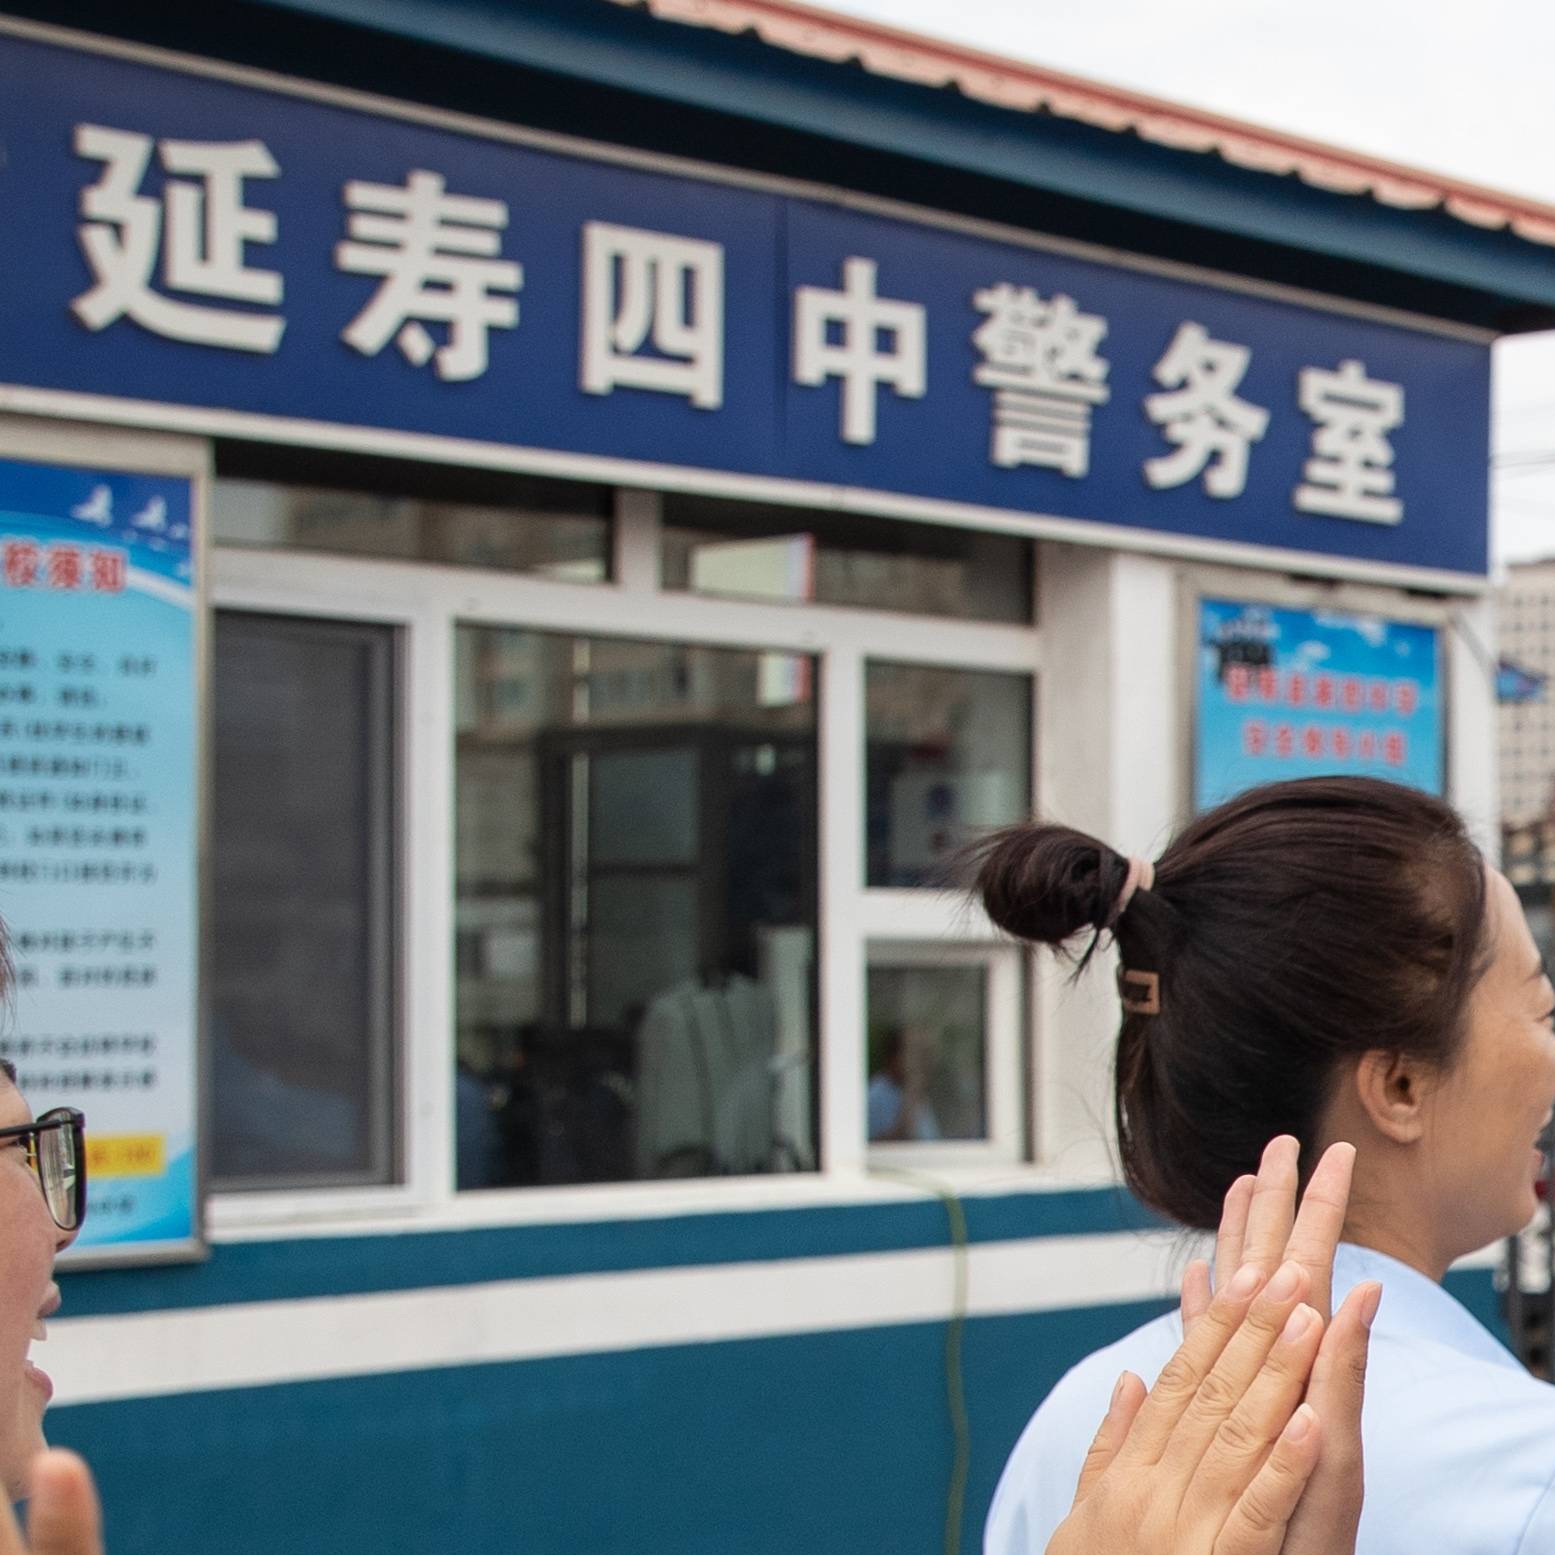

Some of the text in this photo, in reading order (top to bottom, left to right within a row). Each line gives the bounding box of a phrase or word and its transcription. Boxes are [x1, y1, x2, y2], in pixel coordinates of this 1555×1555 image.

[70, 121, 1406, 527] 延寿四中警务室
